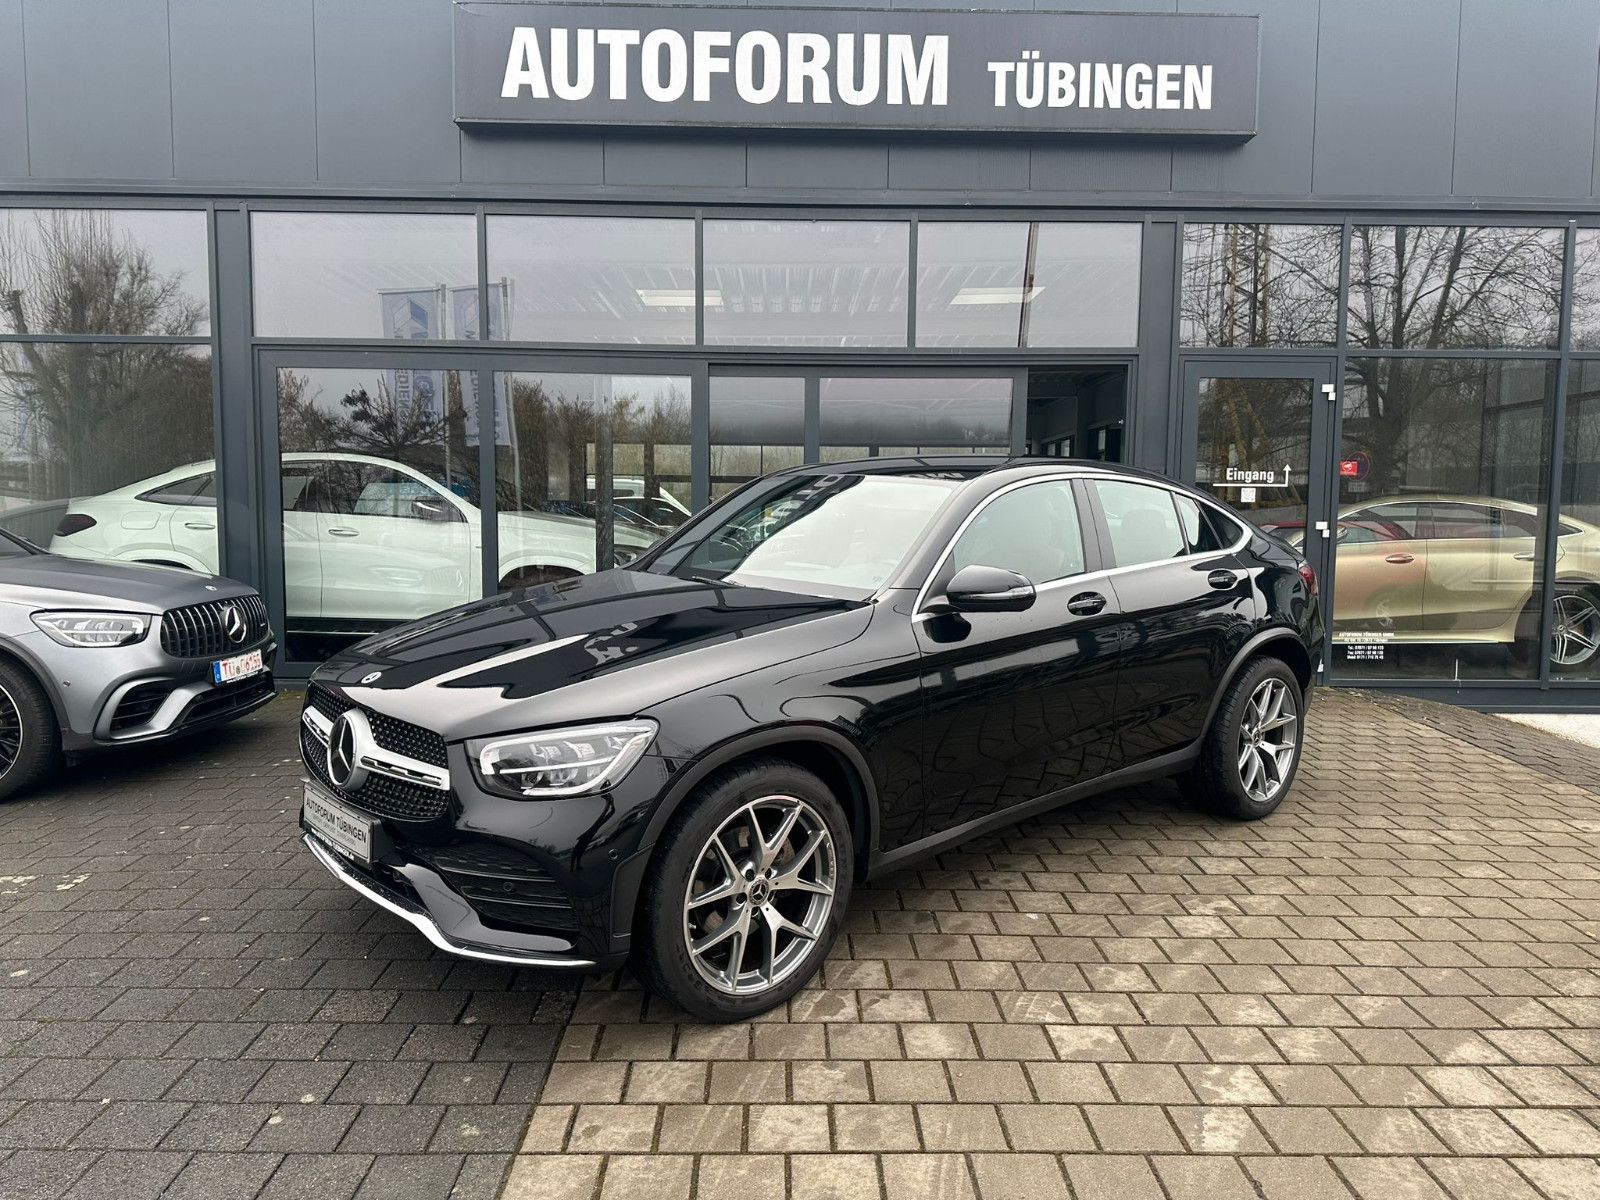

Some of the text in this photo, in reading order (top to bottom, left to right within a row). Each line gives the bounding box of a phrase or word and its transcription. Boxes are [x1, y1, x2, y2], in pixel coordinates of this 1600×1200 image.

[501, 26, 1213, 110] AUTOFORUM TÜBINGEN
[1226, 467, 1275, 483] Eingang
[306, 797, 336, 824] AUTOFORUM
[336, 815, 367, 843] TÜBINGEN
